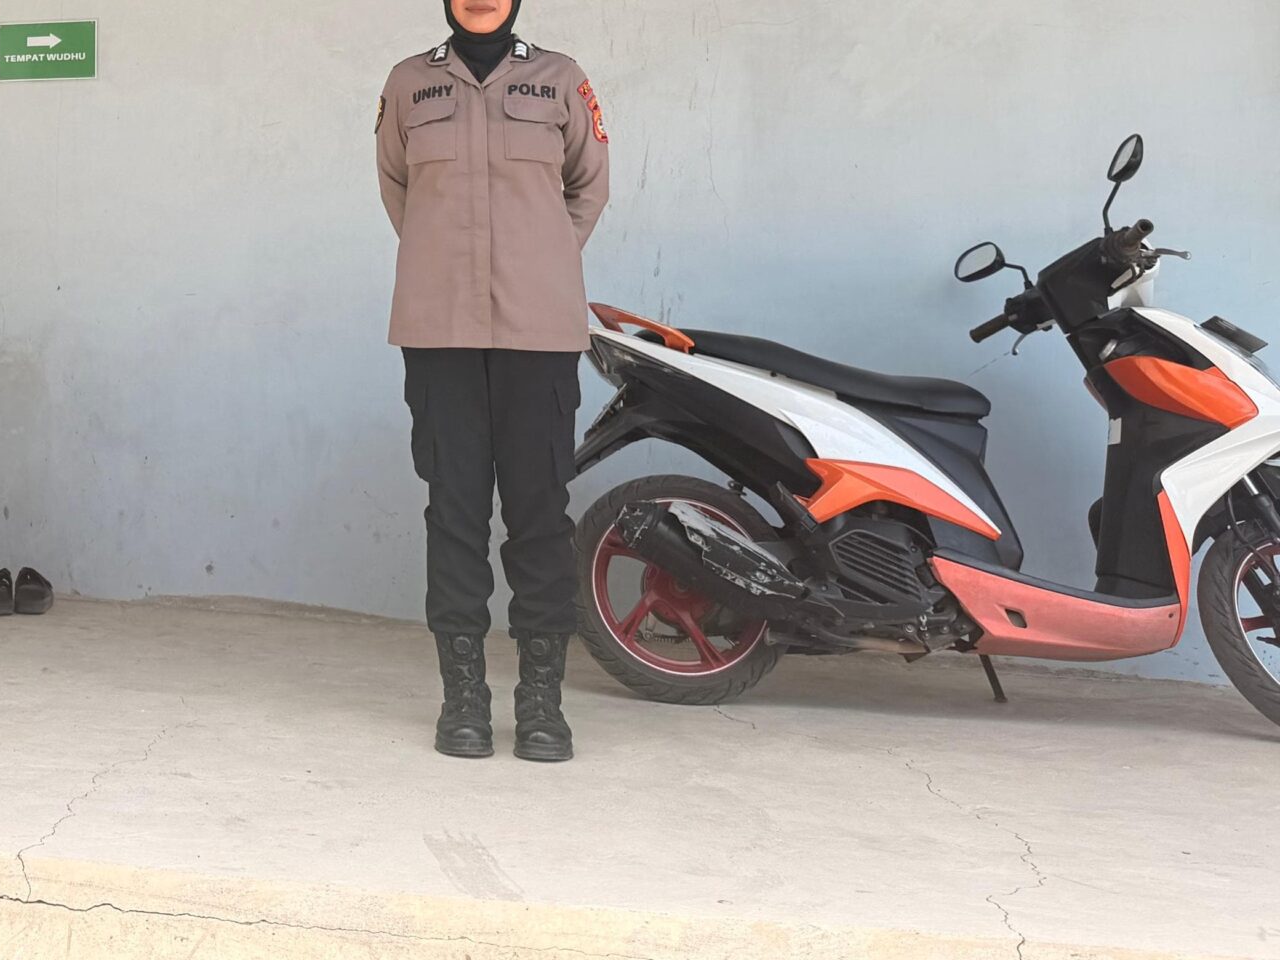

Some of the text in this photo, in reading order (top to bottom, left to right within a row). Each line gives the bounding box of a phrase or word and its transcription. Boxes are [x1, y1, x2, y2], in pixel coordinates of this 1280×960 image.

[4, 52, 86, 63] TEMPAT WUDHU
[412, 84, 454, 105] UNHY
[507, 83, 556, 100] POLRI
